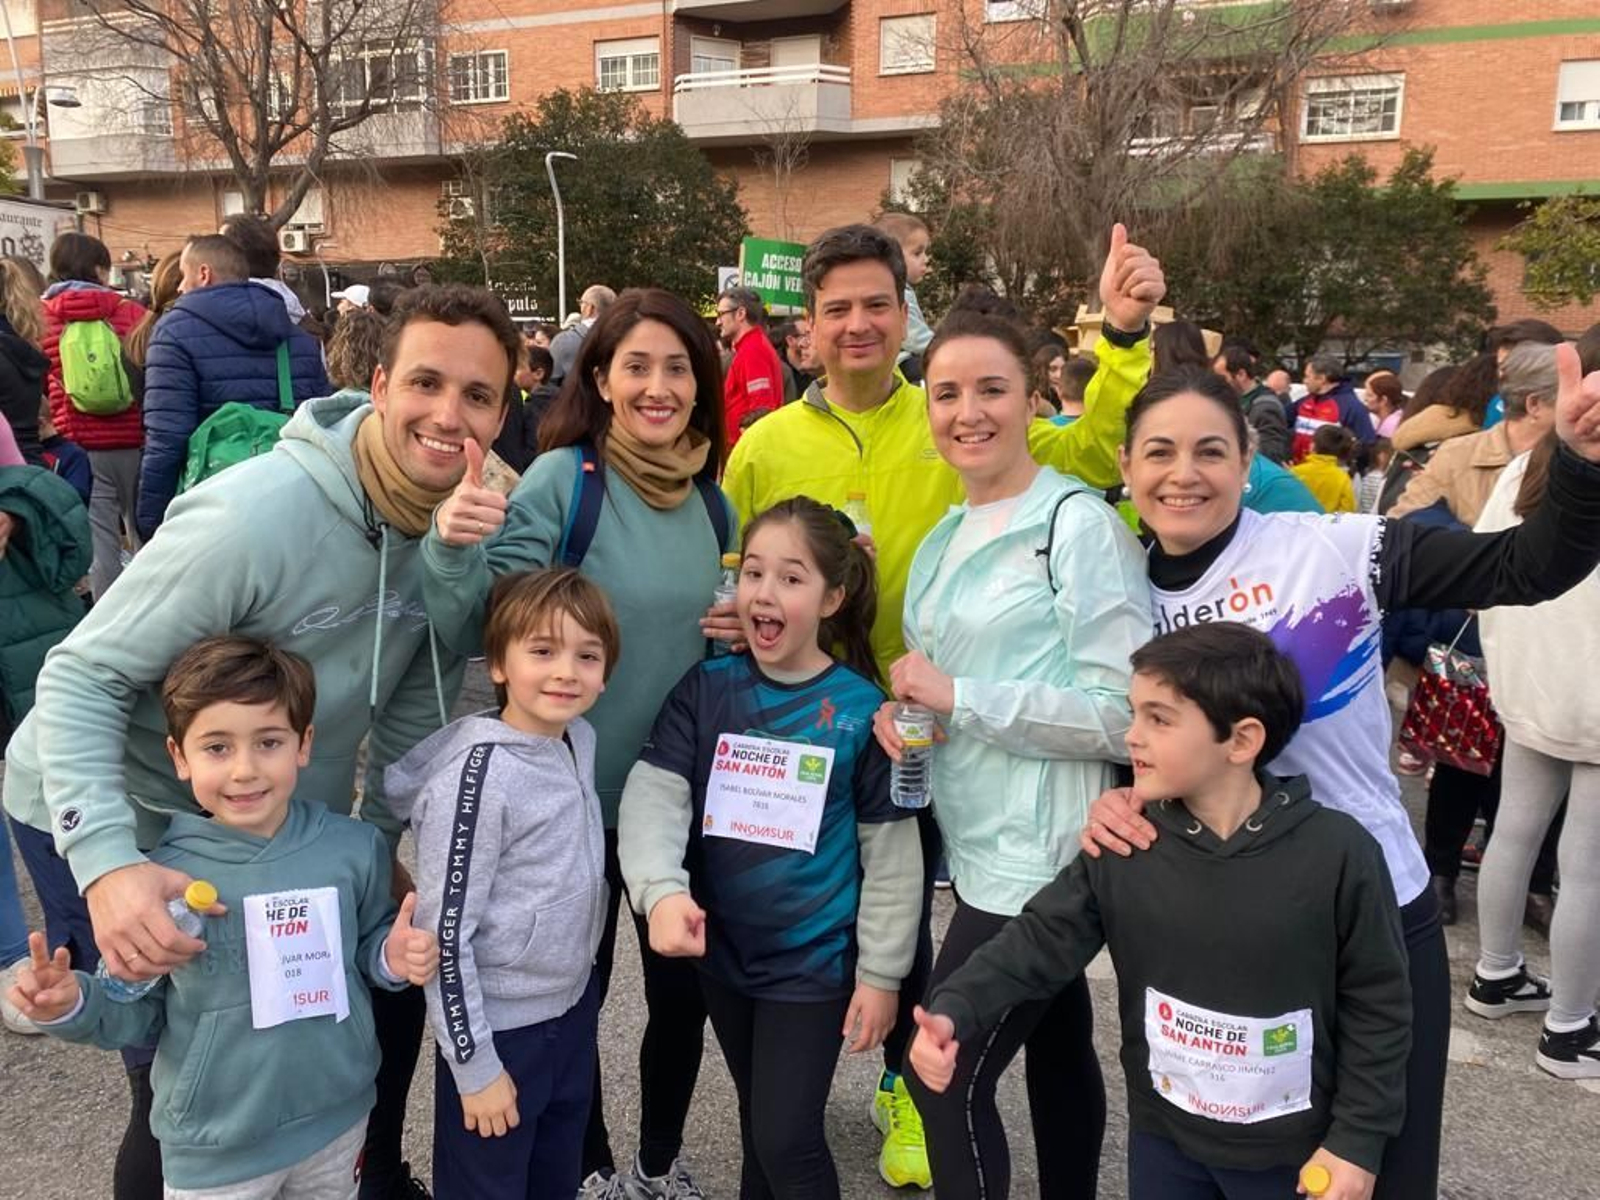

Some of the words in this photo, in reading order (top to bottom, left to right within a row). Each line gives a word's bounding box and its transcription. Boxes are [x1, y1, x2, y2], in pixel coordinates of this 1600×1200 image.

[762, 253, 802, 272] ACCESO
[744, 271, 781, 290] CAJÓN
[731, 749, 771, 764] NOCHE
[773, 755, 788, 766] DE
[462, 746, 487, 813] HILFIGER
[715, 760, 740, 773] SAN
[742, 763, 786, 779] ANTÓN
[731, 821, 794, 841] INNOVASUR
[450, 823, 469, 895] TOMMY
[273, 898, 309, 908] ESCOLAR
[289, 906, 308, 919] DE
[442, 906, 458, 983] HILFIGER
[447, 993, 472, 1059] TOMMY
[1176, 1017, 1222, 1039] NOCHE
[1227, 1031, 1247, 1042] DE
[1161, 1024, 1187, 1045] SAN
[1190, 1036, 1247, 1056] ANTÓN
